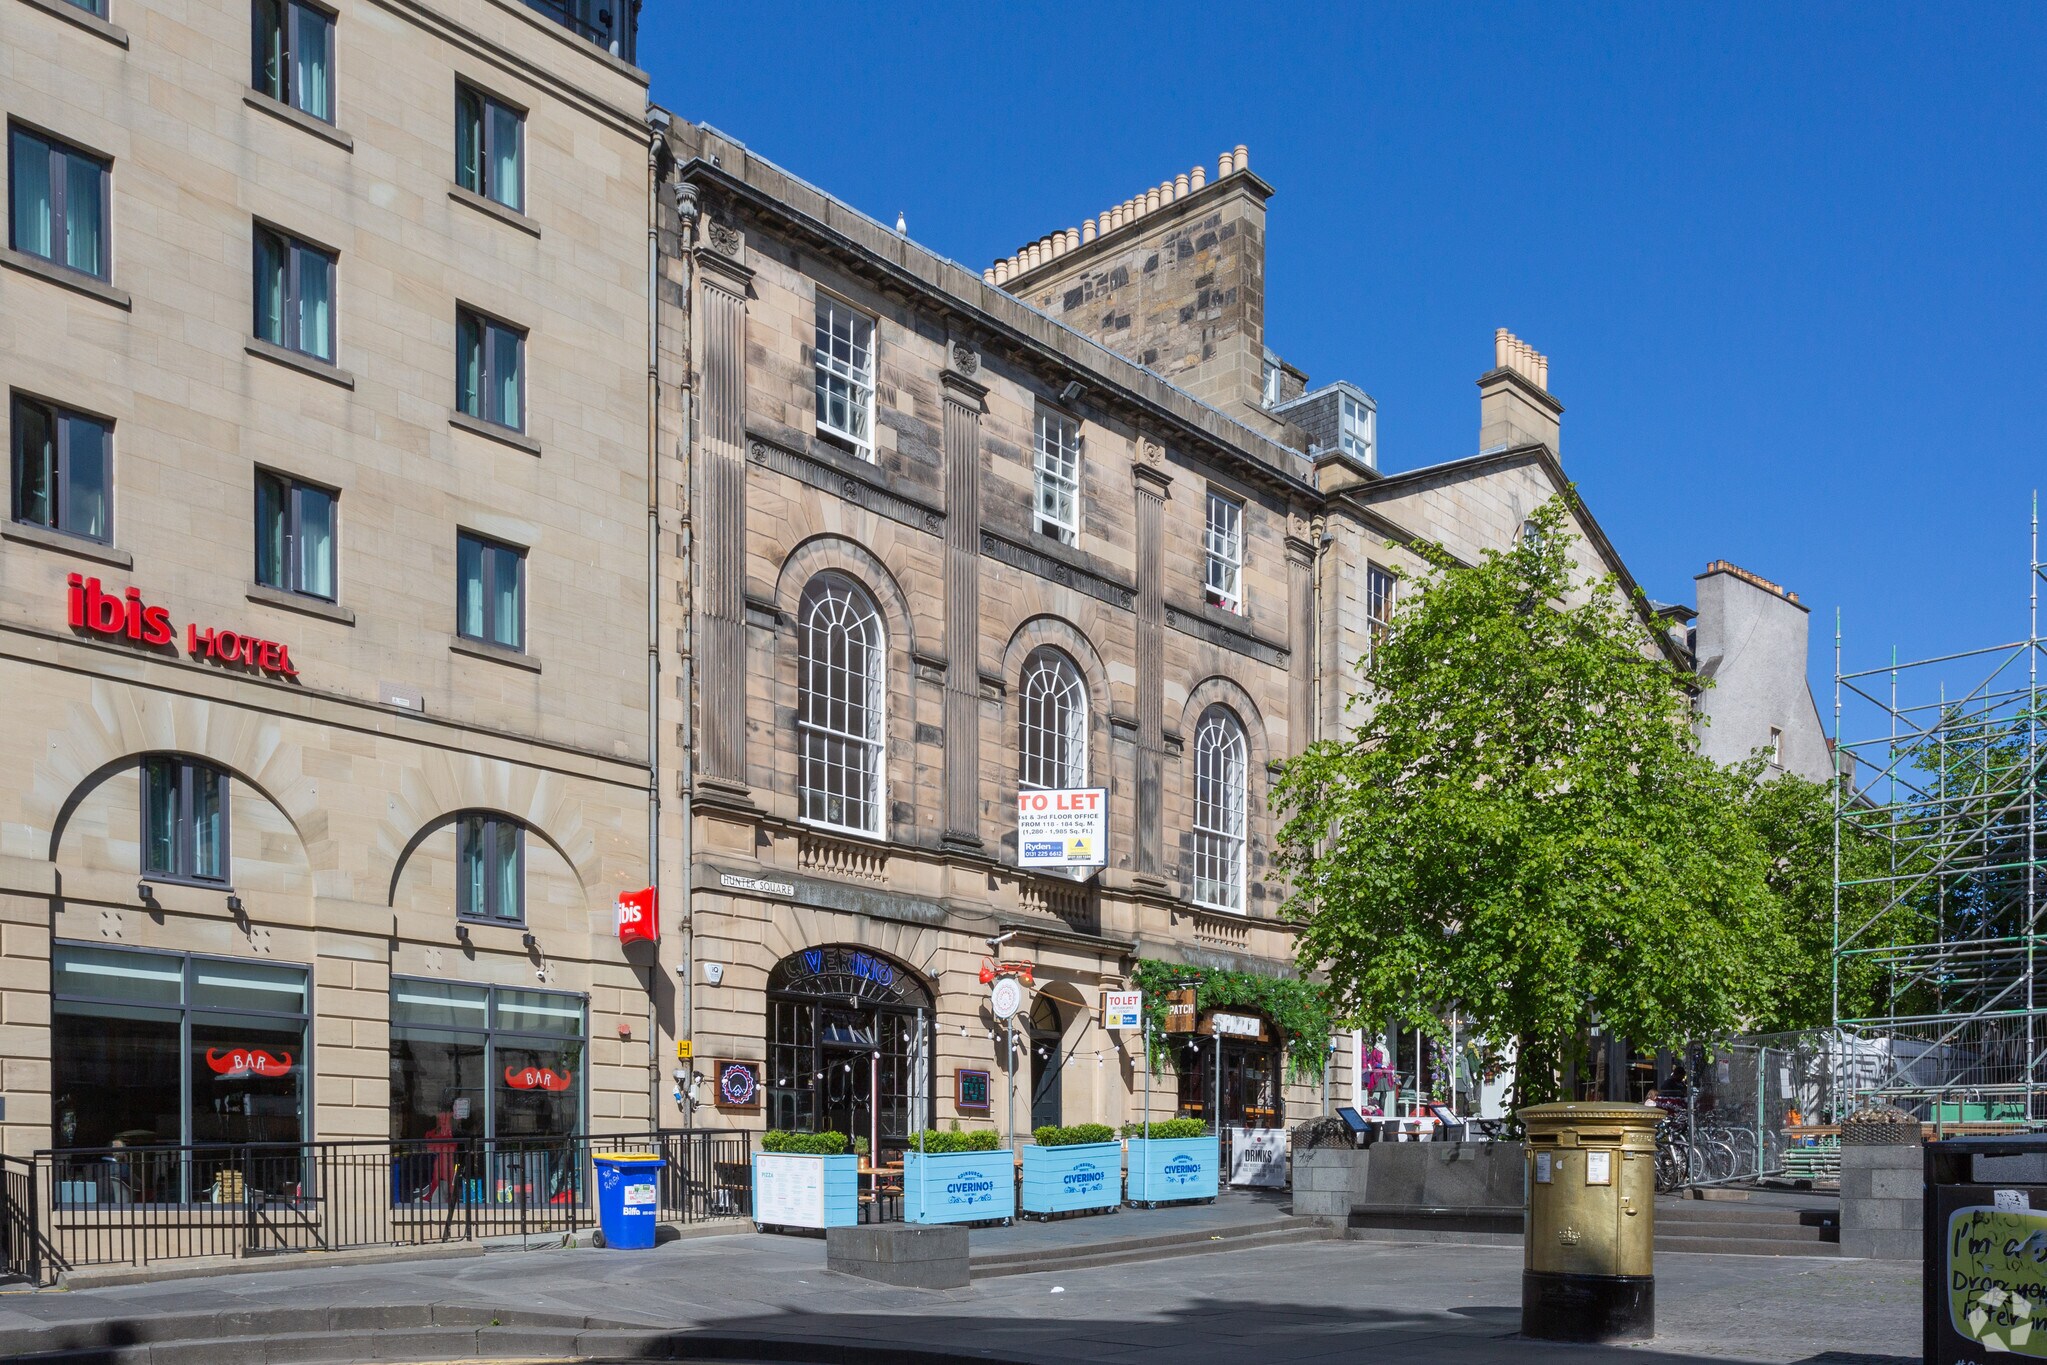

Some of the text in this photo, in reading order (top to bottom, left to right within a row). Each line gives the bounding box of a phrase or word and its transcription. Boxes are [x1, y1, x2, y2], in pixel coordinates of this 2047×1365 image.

[67, 572, 300, 676] ibis HOTEL
[1018, 793, 1099, 811] TO LET
[723, 874, 792, 895] HUNTER SQUARE
[618, 901, 642, 924] ibis
[1109, 996, 1139, 1006] TO LET
[1168, 1004, 1194, 1015] PATCH
[679, 1042, 690, 1056] H
[233, 1053, 266, 1071] BAR
[525, 1071, 552, 1087] BAR
[1245, 1149, 1272, 1163] DRINKS
[622, 1206, 641, 1216] Biffa
[1953, 1222, 1992, 1258] I'm
